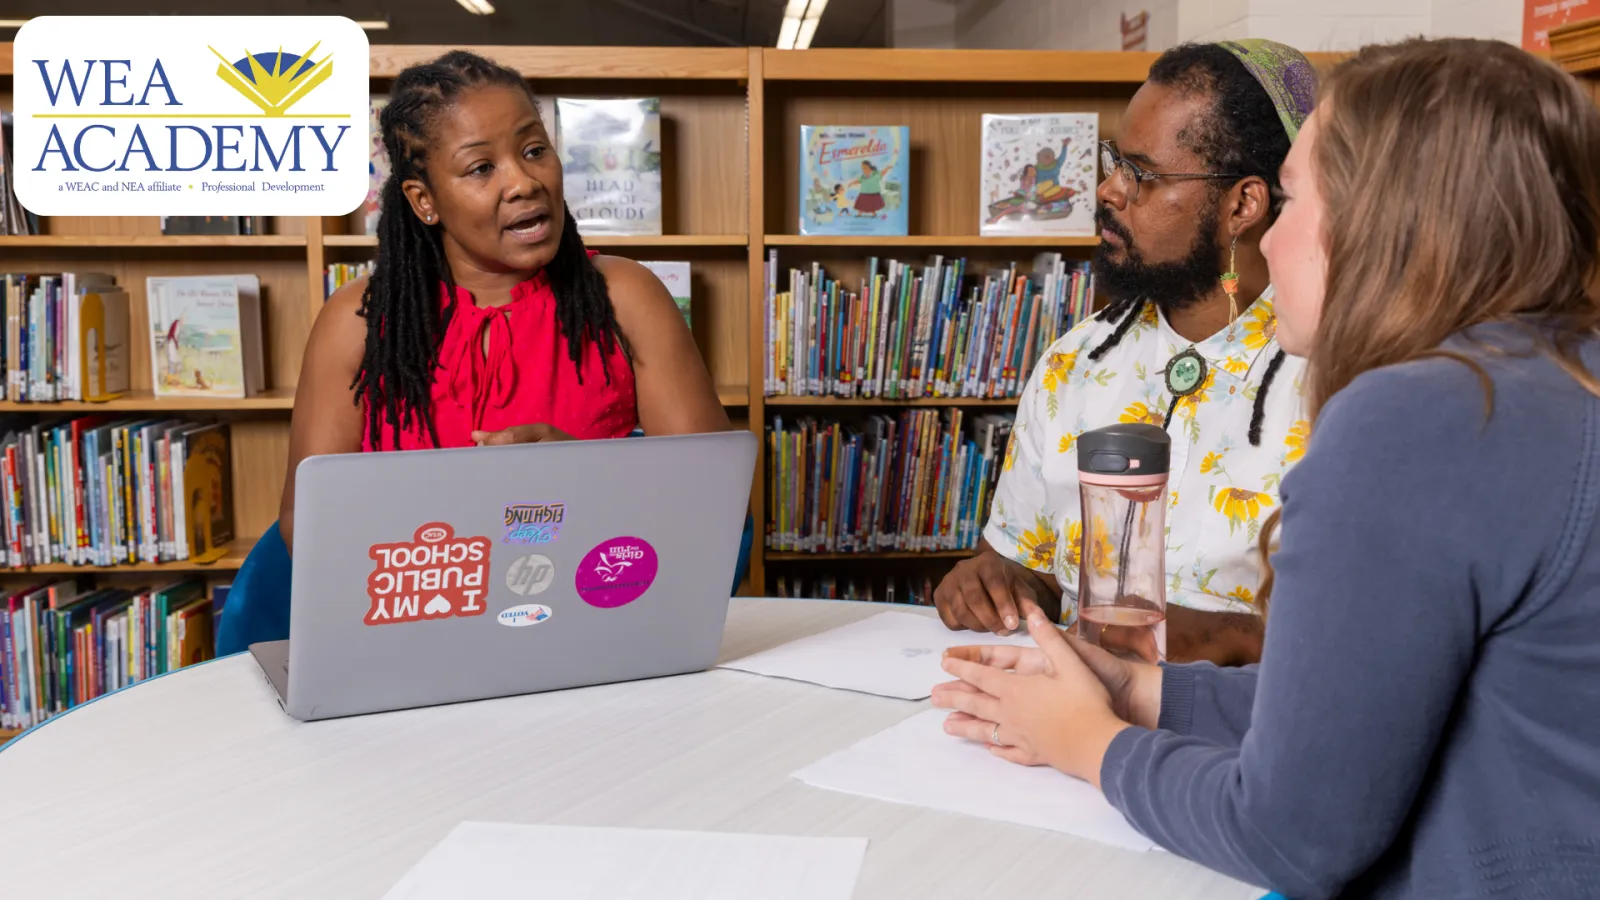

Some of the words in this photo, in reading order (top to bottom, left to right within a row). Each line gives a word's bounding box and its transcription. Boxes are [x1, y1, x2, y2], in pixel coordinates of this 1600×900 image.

[585, 179, 634, 192] HEAD
[619, 194, 637, 205] OF
[576, 207, 645, 220] CLOUDS
[503, 505, 564, 526] FIGHTING
[509, 524, 551, 544] Keep
[375, 541, 485, 569] SCHOOL
[609, 545, 631, 554] run
[615, 550, 644, 561] Girls
[374, 564, 484, 595] PUBLIC
[370, 595, 420, 621] MY
[461, 589, 482, 612] I
[501, 610, 529, 618] VOTED
